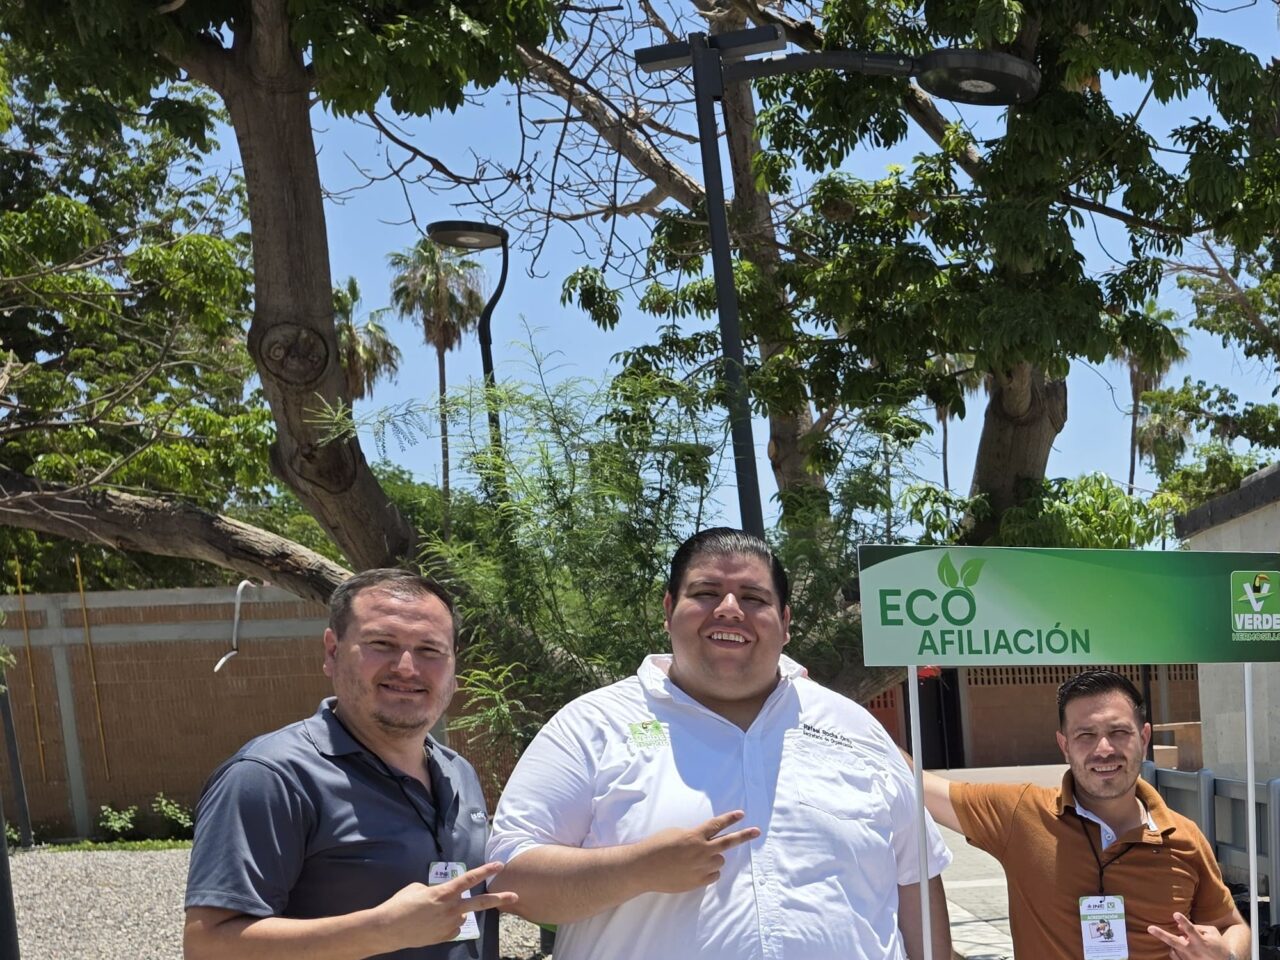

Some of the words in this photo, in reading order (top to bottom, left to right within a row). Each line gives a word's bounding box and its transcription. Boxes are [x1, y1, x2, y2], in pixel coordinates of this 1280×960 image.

[879, 586, 976, 626] ECO
[1234, 613, 1280, 630] VERDE
[917, 622, 1090, 656] AFILIACIÓN
